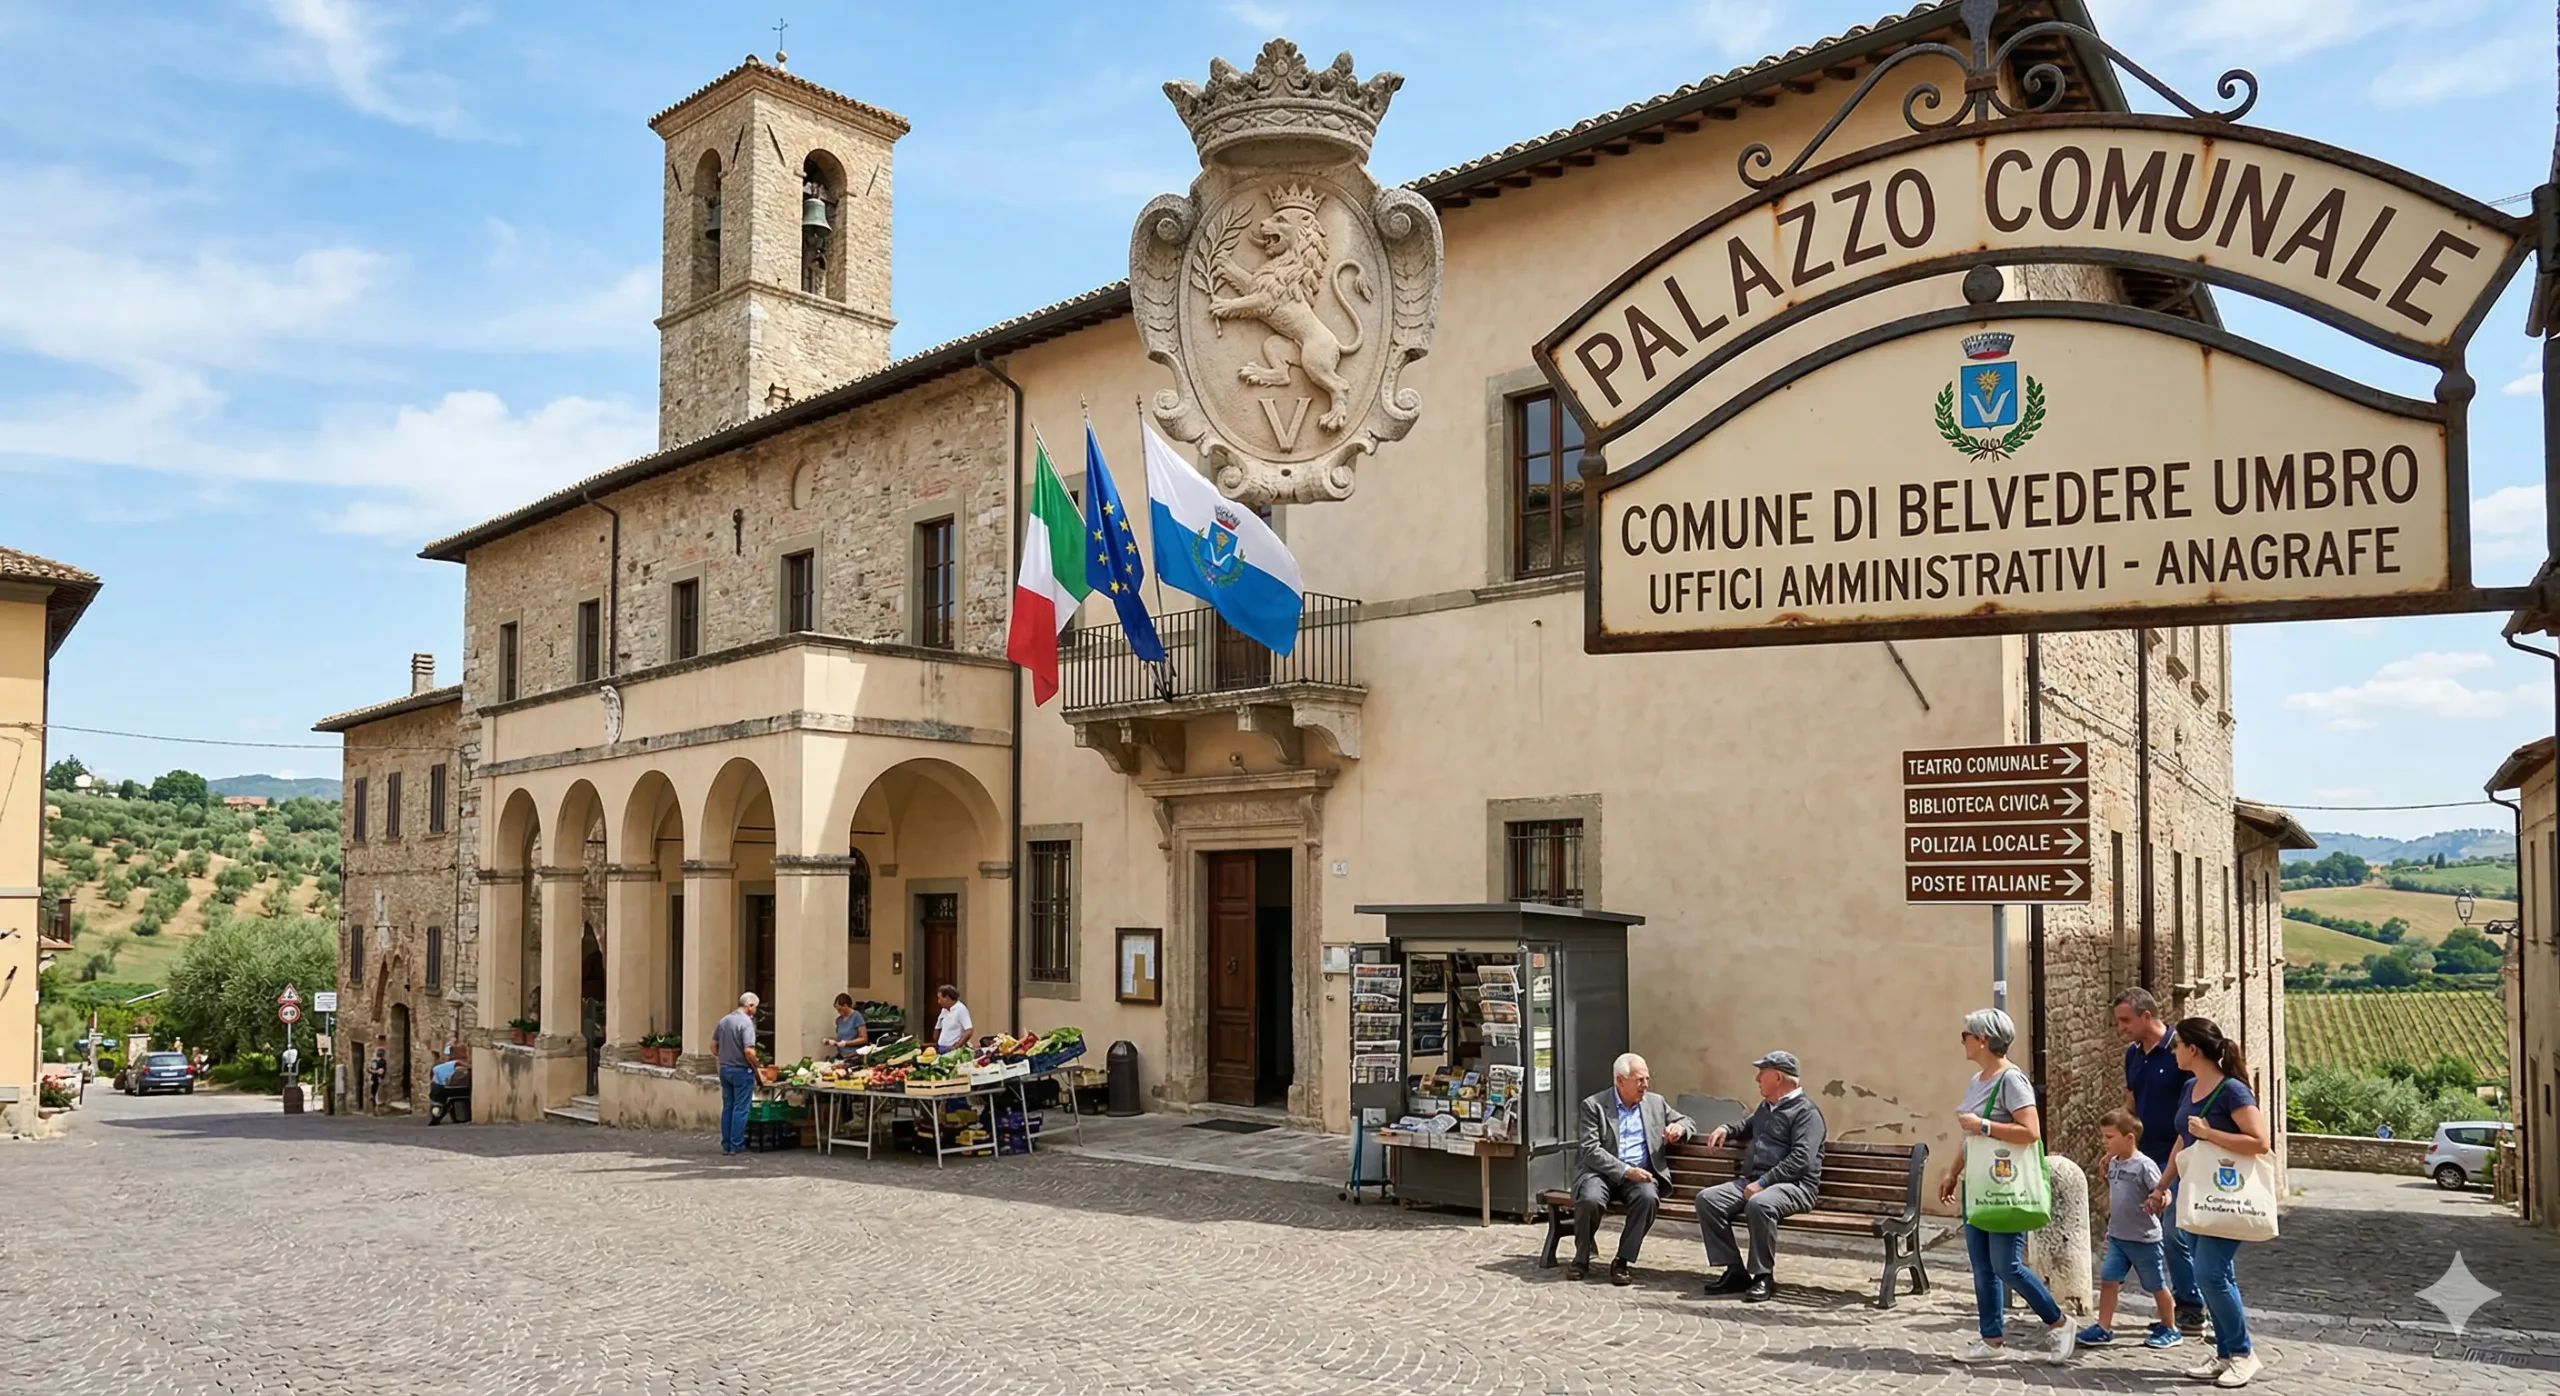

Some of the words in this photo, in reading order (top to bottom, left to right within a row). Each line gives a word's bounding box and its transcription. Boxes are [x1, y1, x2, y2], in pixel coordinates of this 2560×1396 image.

[1575, 168, 1936, 408] PALAZZO
[1984, 145, 2481, 327] COMUNALE
[1621, 491, 1815, 557] COMUNE
[1833, 486, 1877, 542] DI
[1899, 461, 2192, 537] BELVEDERE
[2214, 444, 2419, 516] UMBRO
[1649, 567, 1763, 615] UFFICI
[1777, 544, 2106, 608] AMMINISTRATIVI
[2155, 526, 2401, 586] ANAGRAFE
[1907, 757, 1962, 776] TEATRO
[1966, 753, 2050, 773] COMUNALE
[1909, 796, 1995, 815] BIBLIOTECA
[1999, 793, 2050, 812] CIVICA
[1910, 836, 1977, 854] POLIZIA
[1982, 833, 2051, 852] LOCALE
[1911, 875, 1966, 892] POSTE
[1971, 874, 2052, 892] ITALIANE
